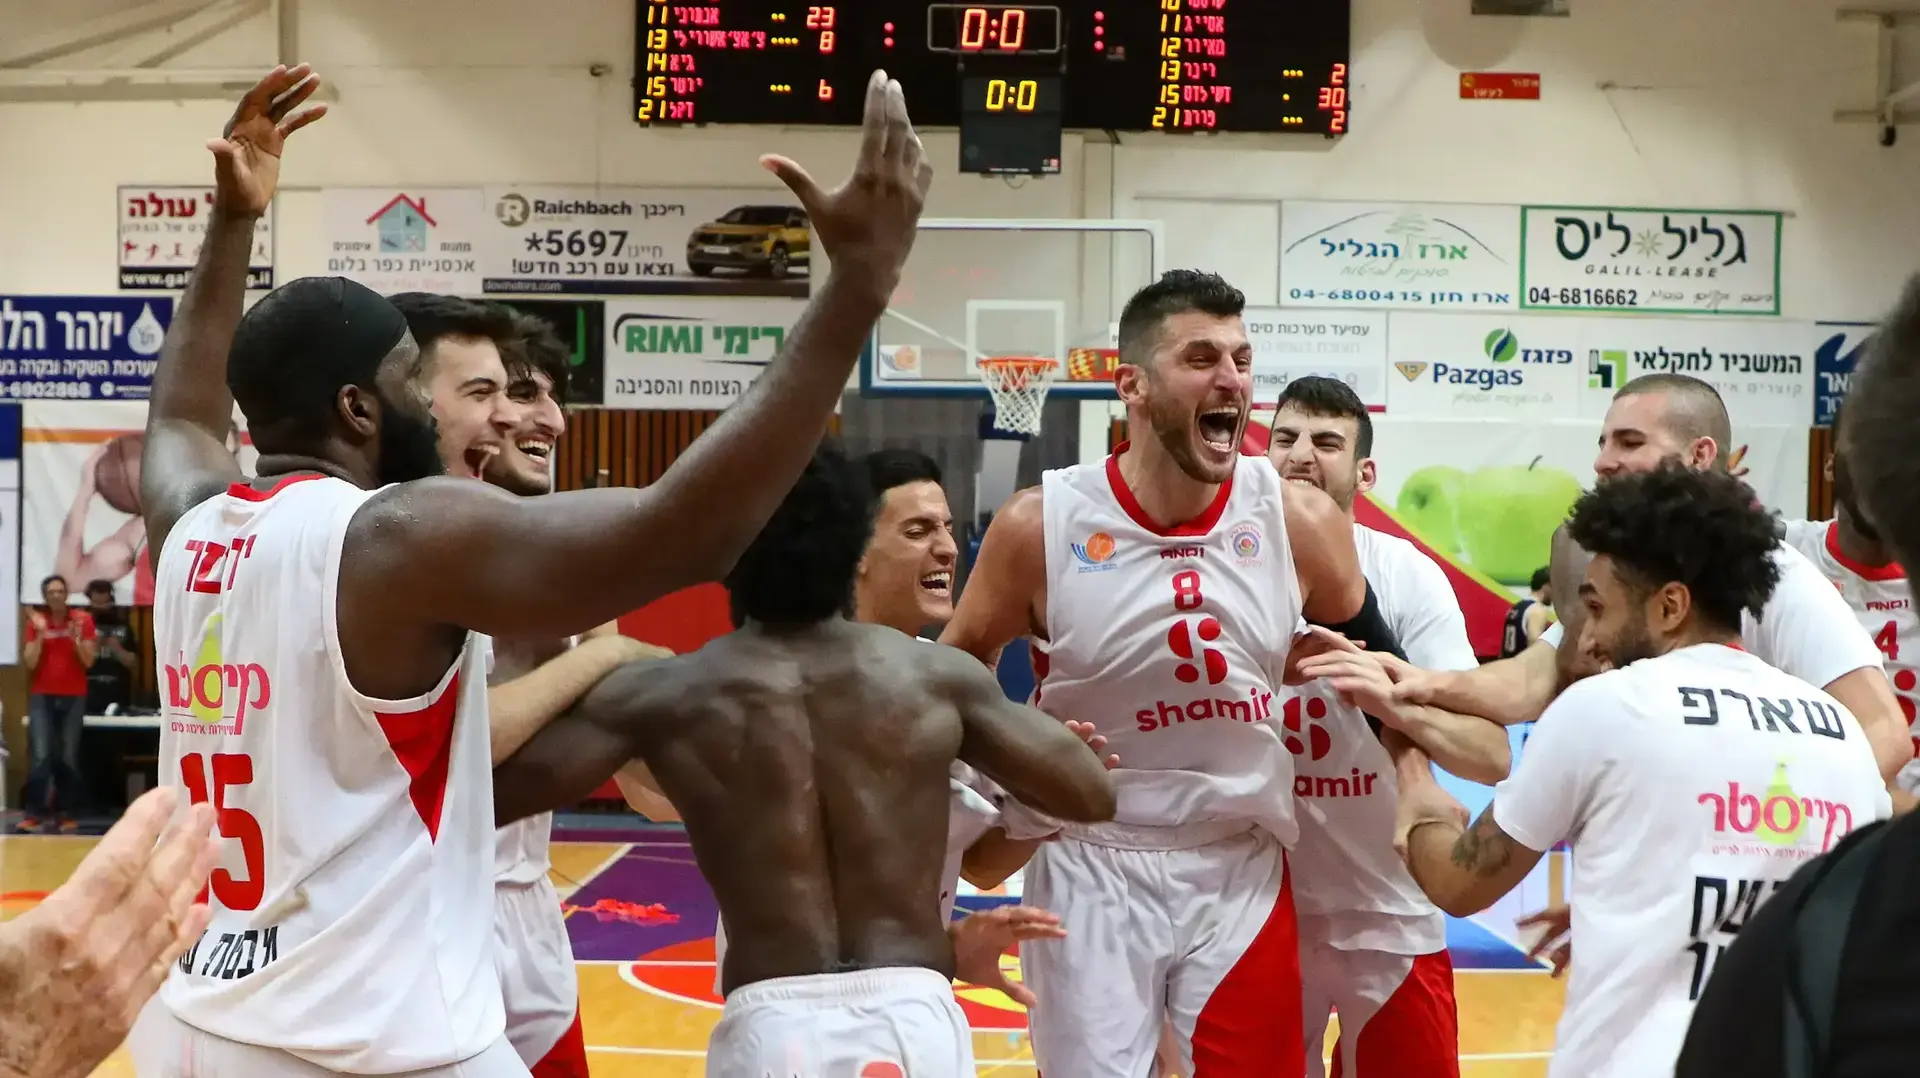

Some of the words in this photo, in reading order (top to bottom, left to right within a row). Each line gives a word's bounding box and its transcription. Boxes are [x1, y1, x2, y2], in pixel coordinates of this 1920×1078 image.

[648, 5, 668, 24] 11
[806, 6, 836, 29] 23
[1160, 13, 1181, 33] 11
[961, 8, 1026, 49] 0:0
[647, 28, 668, 49] 13
[820, 31, 835, 53] 8
[1160, 37, 1181, 57] 12
[646, 52, 668, 72] 14
[669, 54, 696, 71] גיא
[1160, 60, 1181, 80] 13
[1331, 63, 1346, 85] 2
[646, 76, 666, 96] 15
[819, 79, 834, 101] 6
[985, 79, 1038, 112] 0:0
[1160, 84, 1181, 105] 15
[1318, 87, 1347, 109] 30
[638, 99, 667, 119] 21
[1152, 106, 1180, 128] 21
[1330, 111, 1346, 132] 2
[128, 192, 197, 217] עולה
[533, 199, 632, 216] Raichbach
[642, 203, 685, 219] רייכבך
[1555, 211, 1632, 261] ליס
[1663, 214, 1747, 267] גליל
[1320, 238, 1400, 259] הגליל
[1419, 243, 1469, 260] ארז
[328, 256, 366, 273] בלום
[373, 258, 404, 273] כפר
[409, 258, 476, 273] אכסניית
[511, 259, 560, 275] חדש!
[566, 260, 598, 275] רכב
[604, 261, 629, 275] עם
[637, 261, 674, 276] וצאו
[1290, 287, 1423, 302] 04-6800415
[1430, 291, 1463, 305] חזן
[1471, 291, 1511, 304] ארז
[1529, 286, 1638, 306] 04-6816662
[55, 310, 125, 350] יזהר
[1250, 323, 1274, 334] מים
[1277, 323, 1327, 335] מערכות
[1330, 324, 1371, 337] עמיעד
[625, 325, 704, 354] RIMI
[713, 326, 785, 355] רימי
[1521, 348, 1573, 365] פזגז
[1634, 346, 1713, 374] לחקלאי
[1719, 351, 1803, 374] המשביר
[1433, 362, 1524, 391] Pazgas
[615, 378, 683, 396] והסביבה
[689, 379, 742, 397] הצומח
[1159, 546, 1206, 560] AND1
[1171, 569, 1204, 611] 8
[1866, 598, 1909, 611] AND1
[1135, 686, 1272, 733] shamir
[1677, 686, 1846, 741] שארפ
[1294, 767, 1378, 798] amir
[1697, 780, 1853, 853] מייסטר
